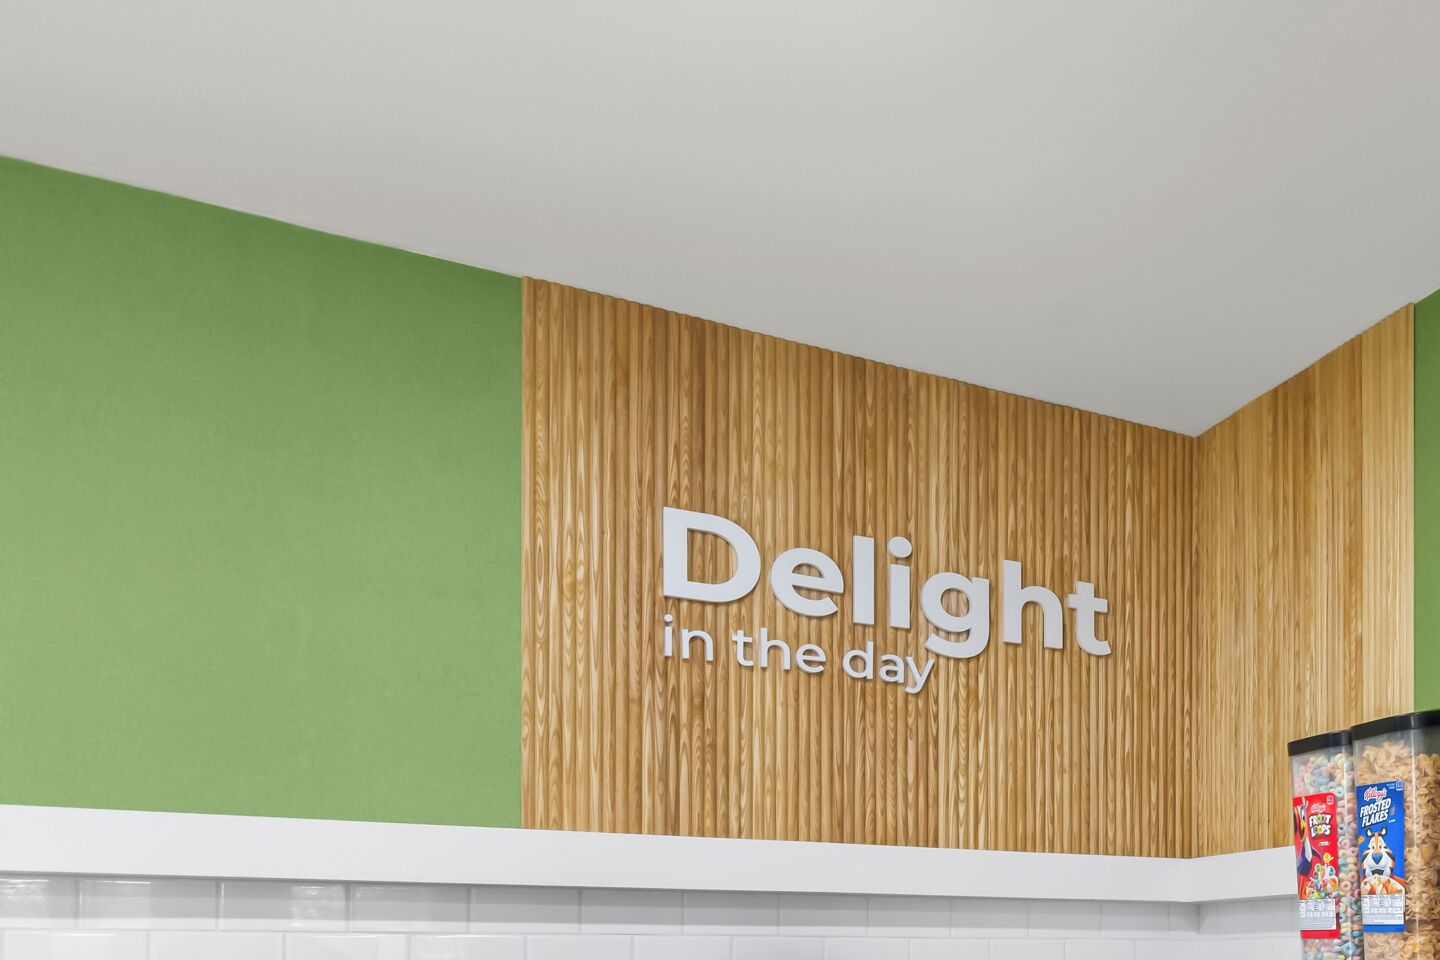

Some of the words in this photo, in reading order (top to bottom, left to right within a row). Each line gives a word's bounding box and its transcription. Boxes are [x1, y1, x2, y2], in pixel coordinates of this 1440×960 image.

[662, 506, 1111, 659] Delight
[663, 614, 714, 662] in
[732, 627, 827, 674] the
[842, 641, 936, 694] day
[1360, 798, 1391, 817] FROSTED
[1309, 813, 1332, 827] FROOT
[1362, 810, 1388, 827] FLAKES
[1310, 824, 1331, 838] LOOPS
